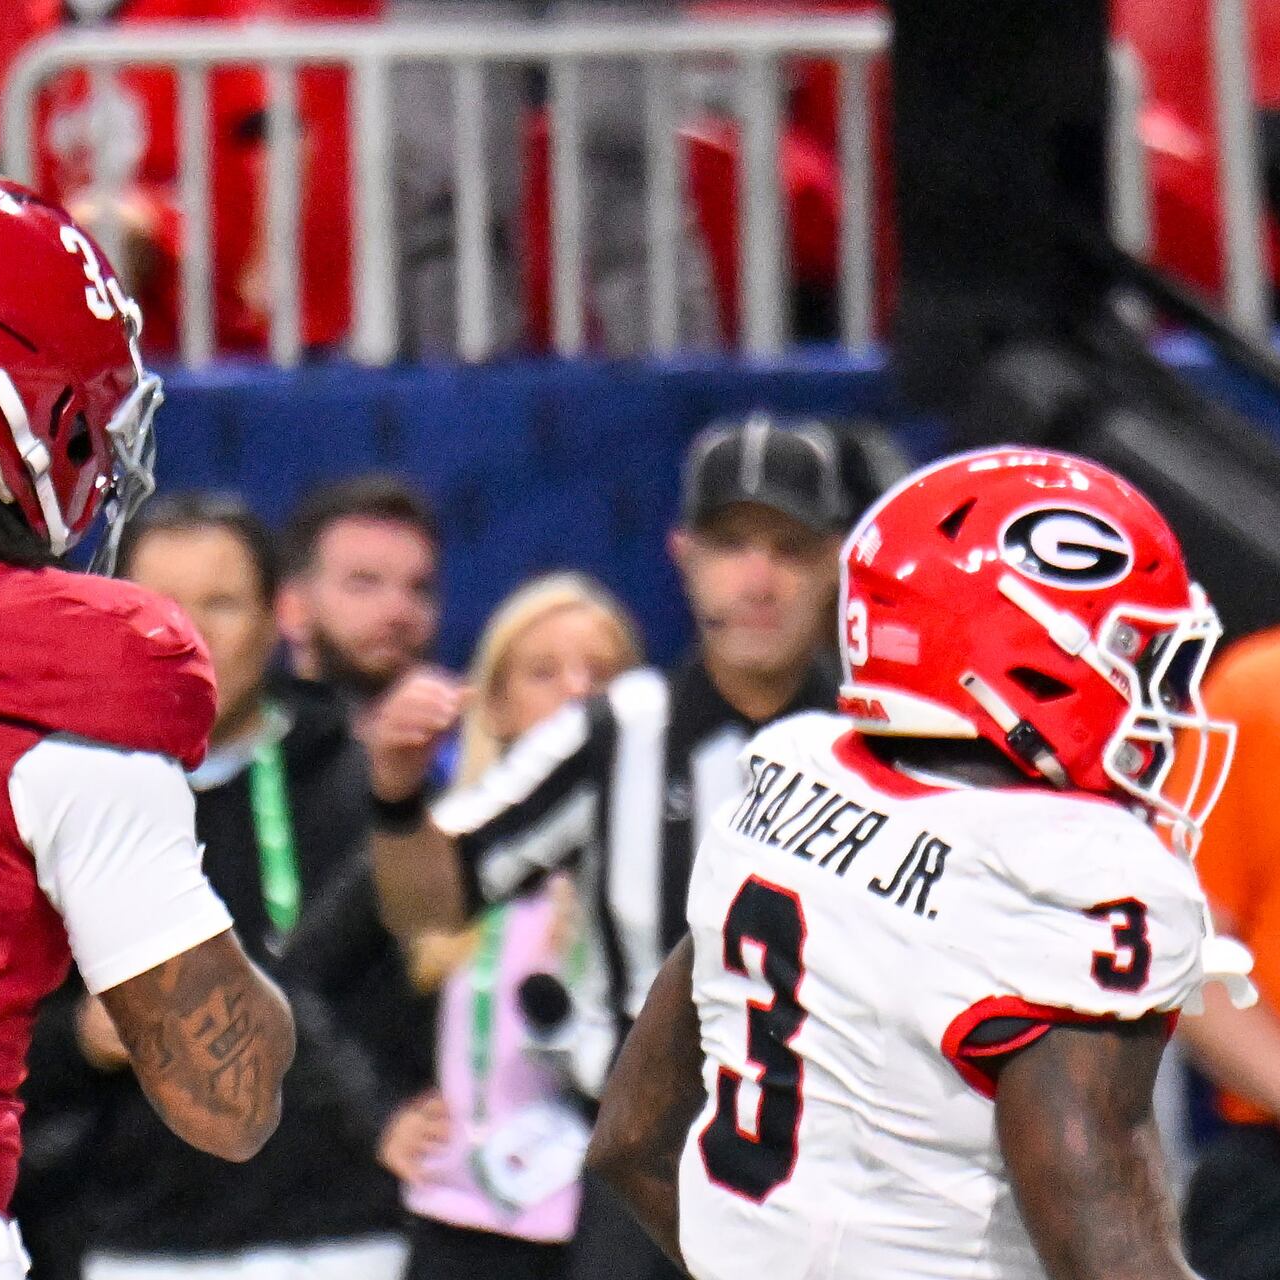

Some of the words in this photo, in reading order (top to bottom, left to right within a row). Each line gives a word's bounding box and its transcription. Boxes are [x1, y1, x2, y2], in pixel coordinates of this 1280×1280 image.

[60, 226, 114, 320] 3
[1023, 510, 1132, 577] G
[847, 599, 869, 667] 3
[728, 754, 889, 877] FRAZIER
[867, 831, 952, 921] JR.
[1085, 896, 1152, 996] 3
[697, 872, 810, 1207] 3
